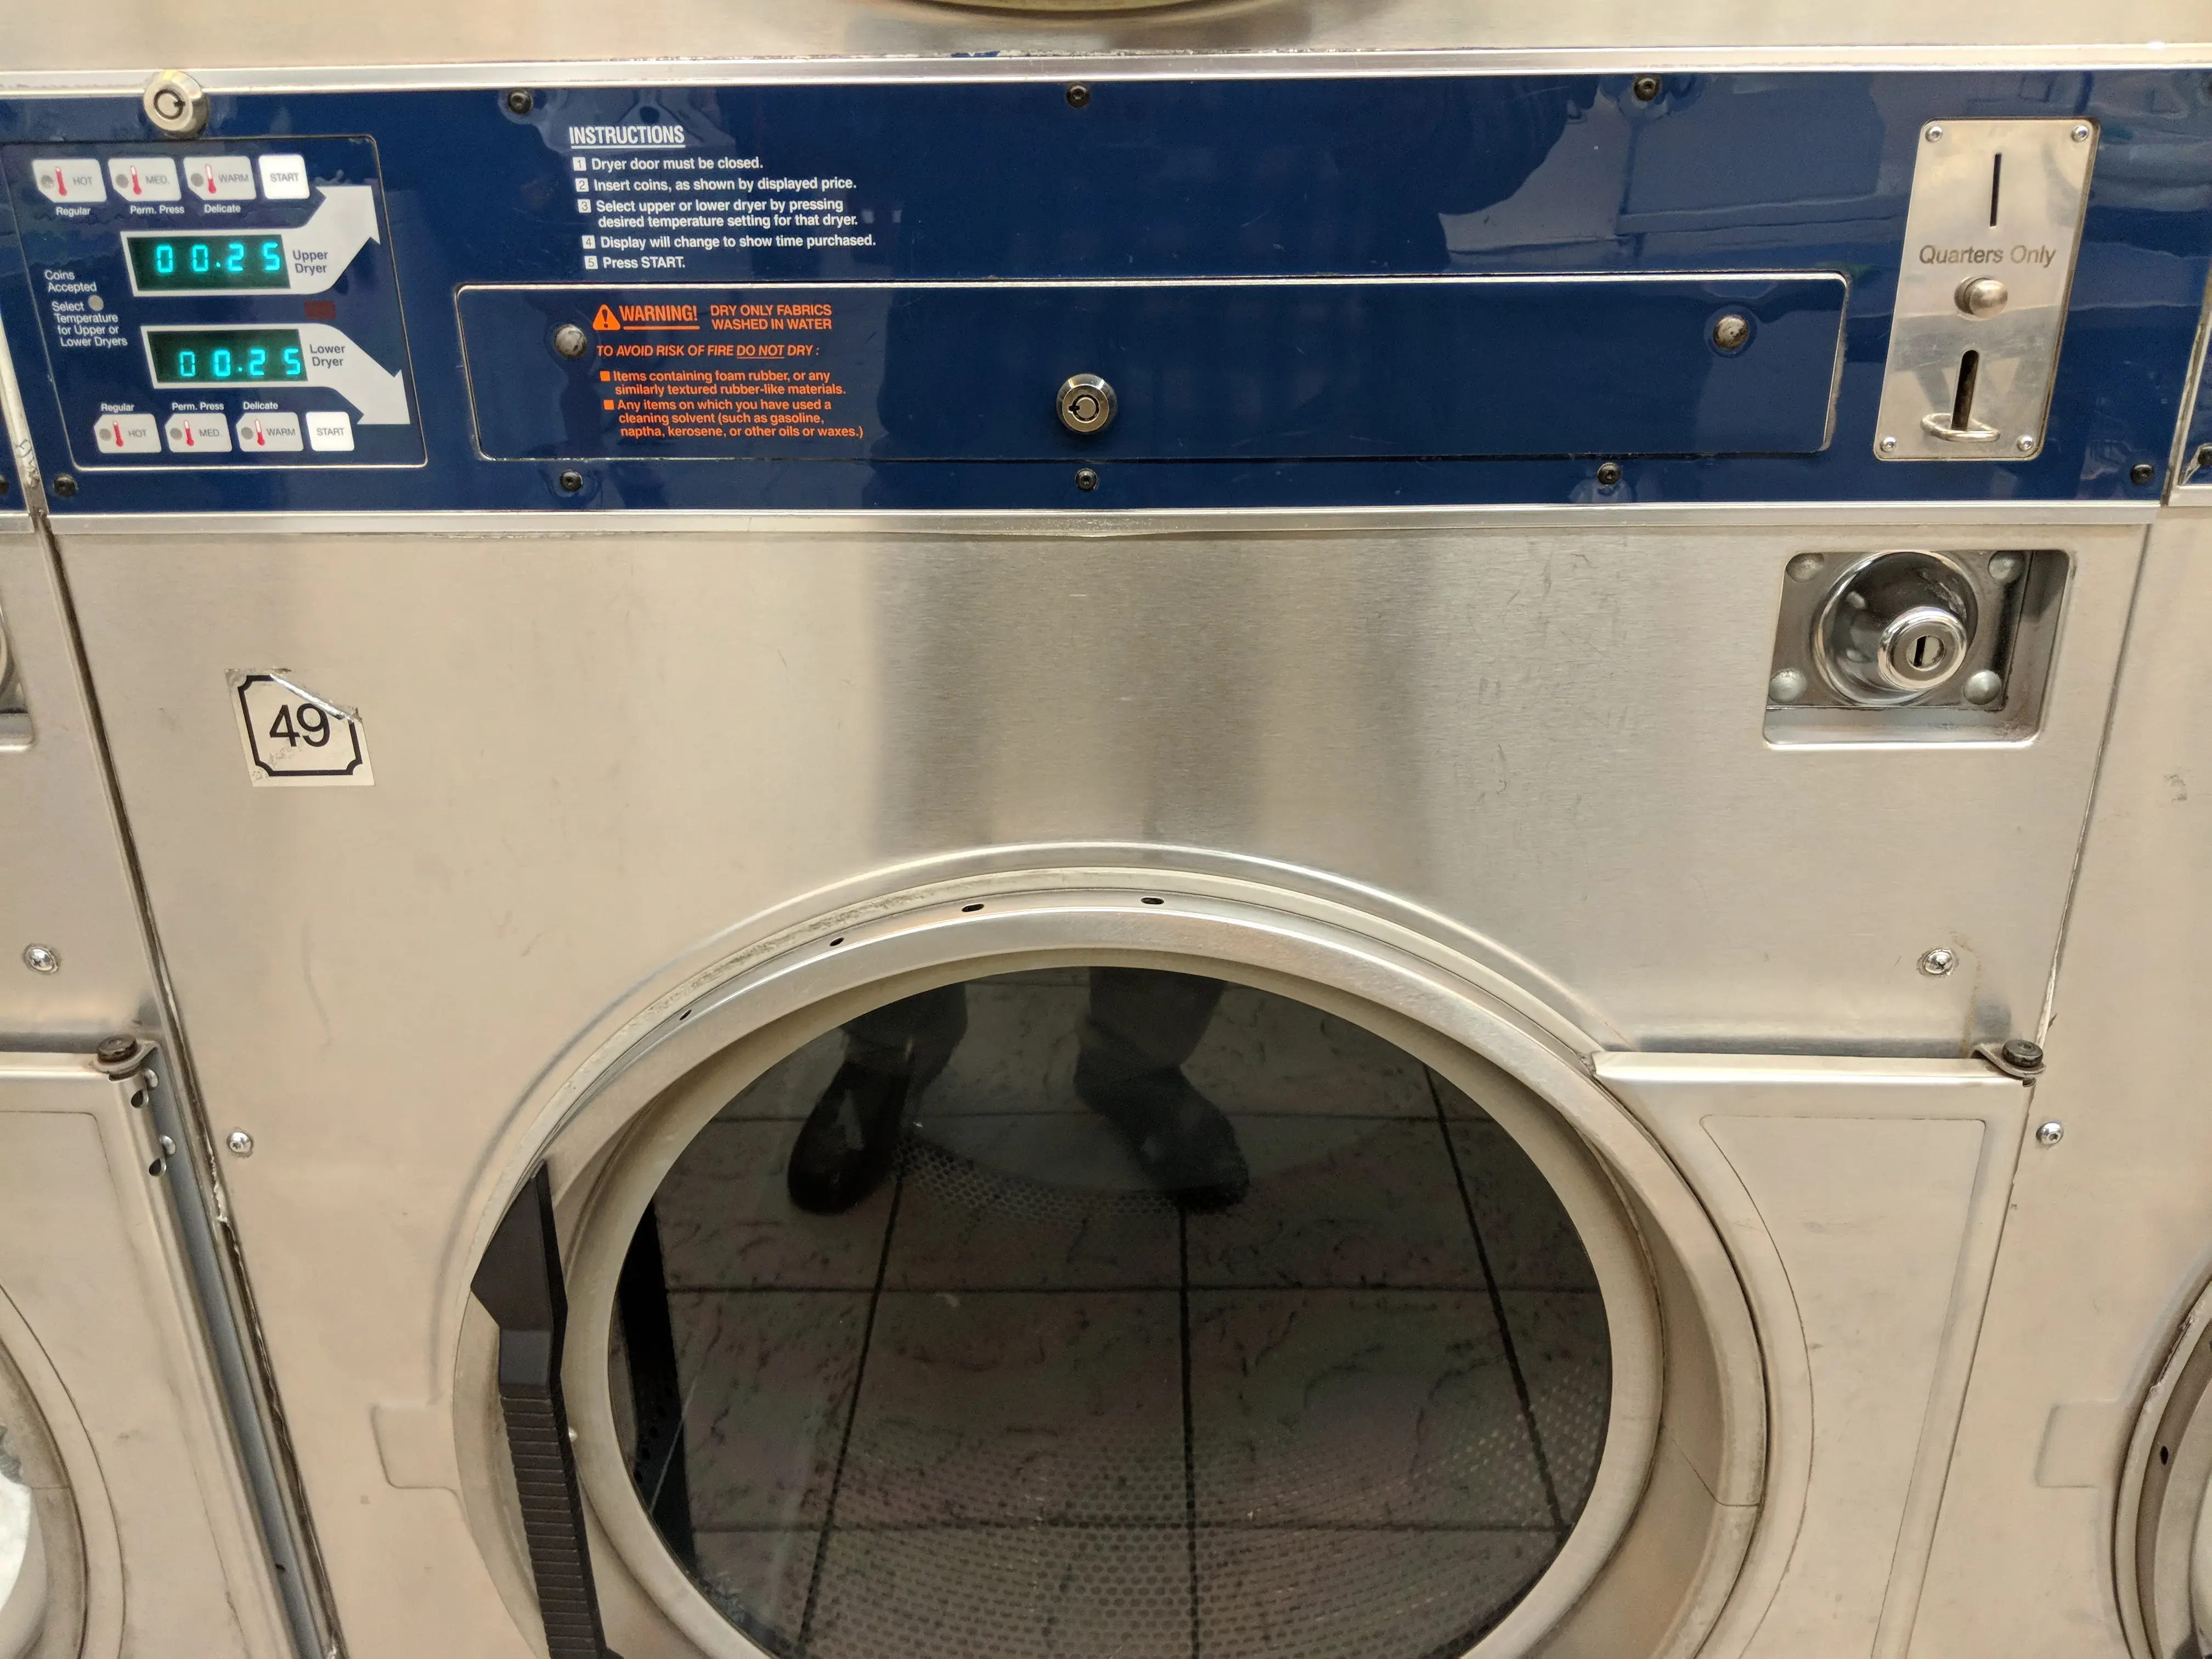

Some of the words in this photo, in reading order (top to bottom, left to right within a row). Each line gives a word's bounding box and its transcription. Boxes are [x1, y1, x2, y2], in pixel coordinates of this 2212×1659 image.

[569, 125, 685, 144] INSTRUCTIONS
[592, 158, 627, 172] Dryer
[630, 158, 659, 170] door
[664, 159, 695, 170] must
[698, 157, 714, 169] be
[718, 157, 763, 169] closed.
[73, 176, 93, 185] HOT
[146, 176, 170, 185] MED.
[218, 173, 249, 182] WARM
[270, 172, 299, 182] START
[594, 179, 630, 191] Insert
[634, 179, 672, 193] coins,
[675, 181, 690, 190] as
[694, 179, 735, 190] shown
[738, 179, 754, 193] by
[758, 178, 817, 192] displayed
[822, 178, 856, 192] price.
[55, 206, 91, 216] Regular
[130, 205, 157, 215] Perm.
[160, 205, 184, 215] Press
[204, 204, 241, 213] Delicate
[596, 200, 635, 212] Select
[639, 201, 675, 215] upper
[679, 202, 691, 211] or
[696, 199, 730, 211] lower
[733, 199, 766, 213] dryer
[770, 199, 786, 213] by
[789, 199, 843, 213] pressing
[599, 216, 644, 228] desired
[648, 216, 723, 230] temperature
[727, 215, 770, 229] setting
[774, 215, 791, 226] for
[795, 215, 820, 226] that
[823, 215, 857, 228] dryer.
[601, 236, 646, 250] Display
[650, 236, 670, 247] will
[674, 236, 719, 250] change
[724, 237, 736, 247] to
[740, 235, 772, 246] show
[776, 235, 803, 246] time
[806, 235, 875, 249] purchased.
[155, 242, 281, 274] 00.25
[292, 250, 329, 262] Upper
[603, 257, 637, 268] Press
[641, 256, 685, 268] START.
[1919, 245, 2004, 265] Quarters
[2011, 245, 2056, 268] Only
[44, 270, 75, 280] Coins
[295, 263, 327, 275] Dryer
[47, 281, 97, 293] Accepted
[52, 301, 84, 312] Select
[710, 305, 736, 316] DRY
[740, 305, 773, 316] ONLY
[777, 305, 832, 316] FABRICS
[55, 313, 119, 325] Temperature
[619, 306, 697, 322] WARNING!
[712, 319, 767, 330] WASHED
[771, 319, 783, 330] IN
[787, 318, 832, 330] WATER
[58, 325, 71, 335] for
[74, 325, 105, 337] Upper
[108, 327, 119, 335] or
[60, 336, 91, 346] Lower
[94, 336, 127, 348] Dryers
[309, 345, 345, 354] Lower
[597, 346, 612, 357] TO
[617, 346, 652, 357] AVOID
[656, 345, 684, 356] RISK
[688, 345, 704, 356] OF
[708, 345, 733, 356] FIRE
[737, 345, 755, 356] DO
[759, 345, 783, 356] NOT
[179, 348, 302, 377] 00.25
[312, 356, 343, 368] Dryer
[613, 371, 646, 382] Items
[650, 371, 712, 383] containing
[715, 371, 745, 381] foam
[749, 371, 790, 383] rubber,
[794, 373, 805, 381] or
[809, 373, 830, 383] any
[615, 384, 664, 397] similarly
[668, 384, 717, 395] textured
[720, 384, 785, 395] rubber-like
[788, 384, 845, 394] materials.
[101, 403, 134, 413] Regular
[172, 402, 198, 411] Perm.
[200, 402, 224, 411] Press
[242, 401, 278, 410] Delicate
[618, 399, 640, 412] Any
[644, 399, 676, 410] items
[680, 402, 694, 410] on
[698, 399, 732, 410] which
[736, 402, 757, 412] you
[761, 399, 789, 410] have
[793, 399, 821, 410] used
[824, 402, 831, 410] a
[619, 413, 668, 425] cleaning
[672, 413, 714, 424] solvent
[718, 413, 749, 425] (such
[753, 415, 767, 423] as
[770, 413, 823, 425] gasoline,
[128, 429, 147, 438] HOT
[199, 428, 222, 438] MED.
[266, 427, 296, 437] WARM
[316, 427, 345, 437] START
[620, 426, 665, 438] naptha,
[668, 426, 726, 438] kerosene,
[730, 428, 741, 437] or
[744, 426, 775, 437] other
[778, 426, 799, 436] oils
[803, 428, 814, 436] or
[818, 426, 863, 438] waxes.)
[269, 703, 330, 747] 49
